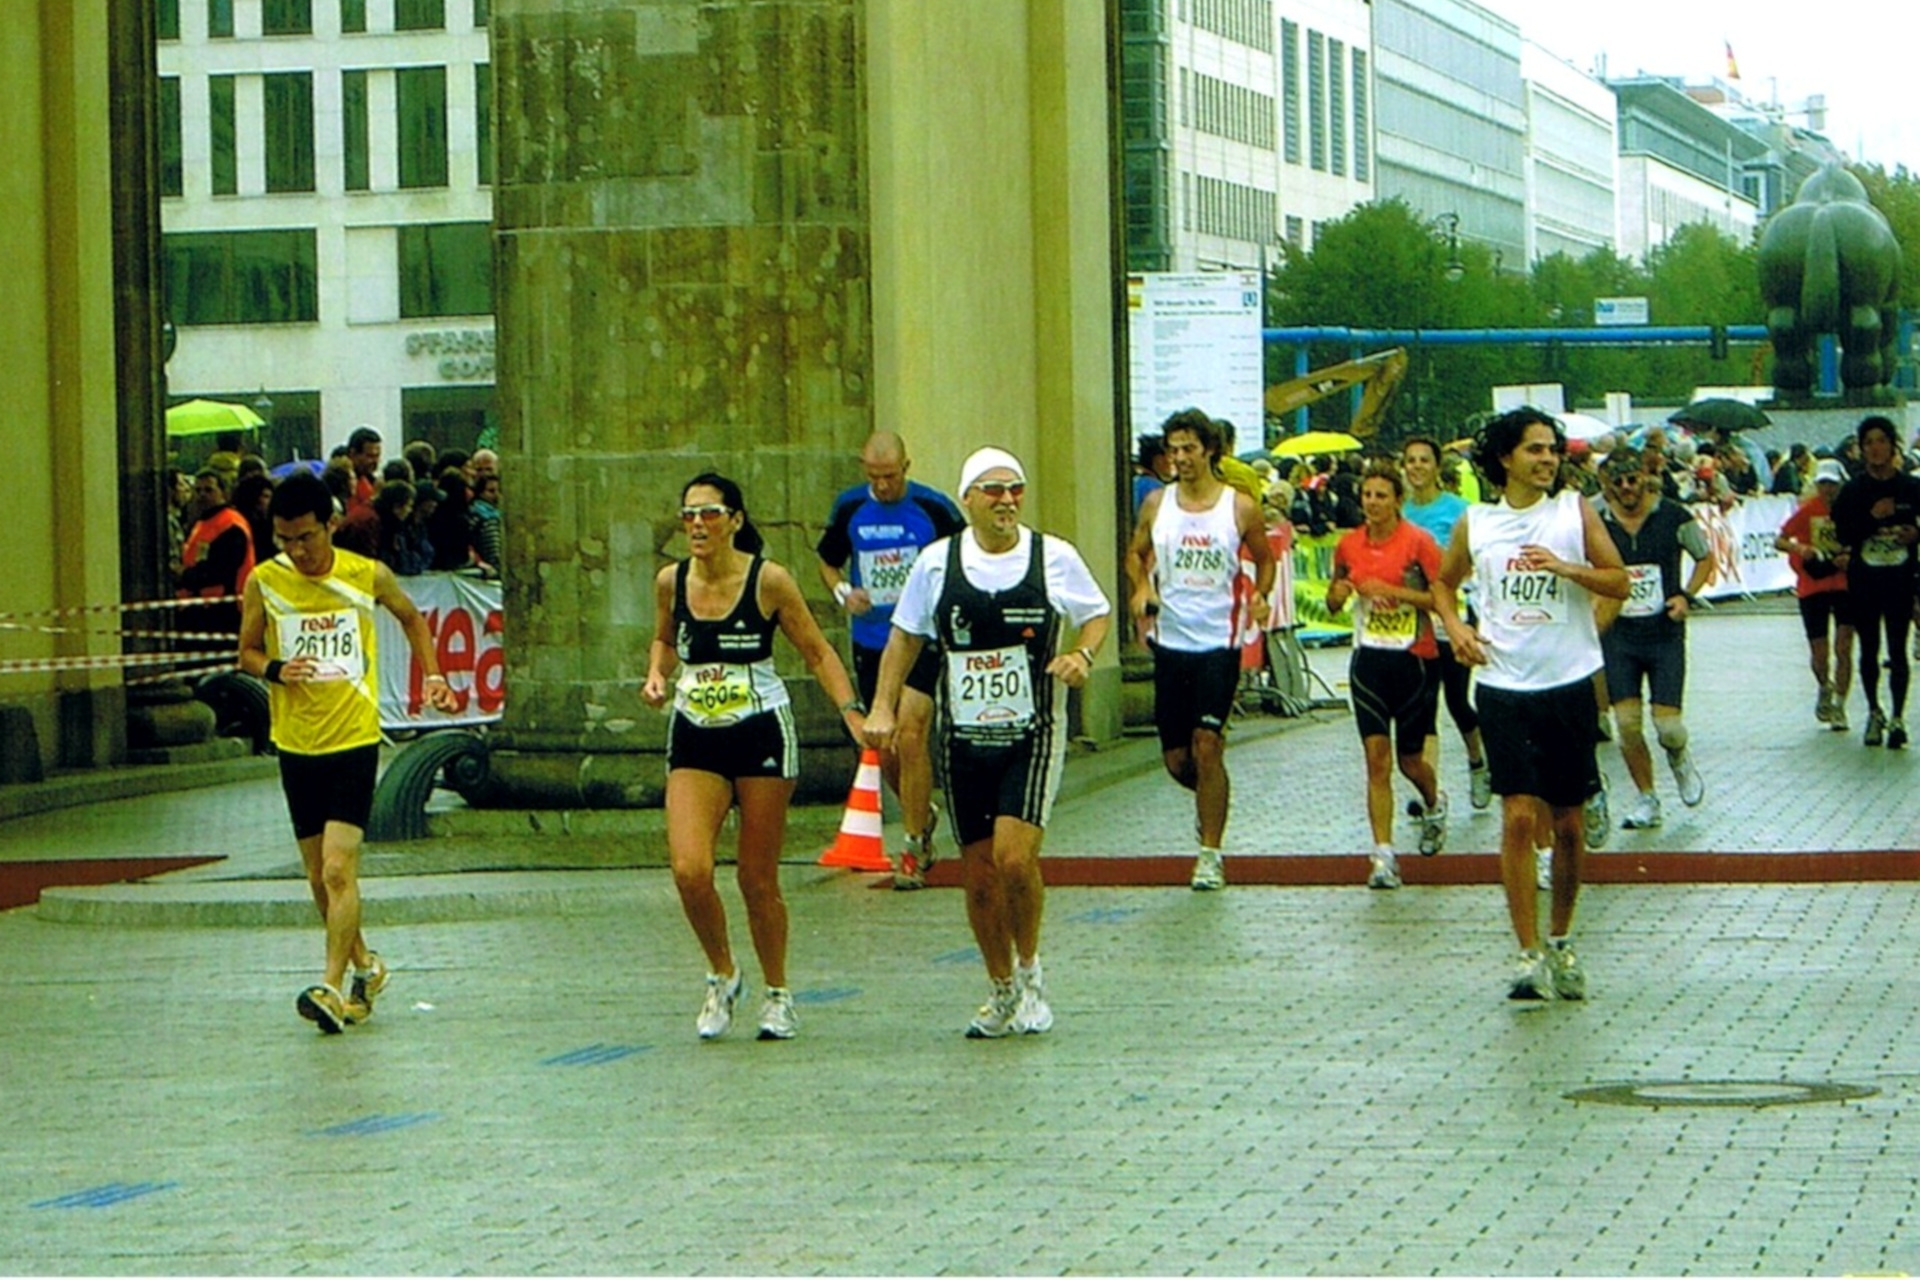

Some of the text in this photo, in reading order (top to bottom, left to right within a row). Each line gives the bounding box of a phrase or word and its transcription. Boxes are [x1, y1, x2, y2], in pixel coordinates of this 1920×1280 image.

[1500, 575, 1557, 600] 14074
[295, 632, 352, 658] 26118
[961, 669, 1019, 701] 2150
